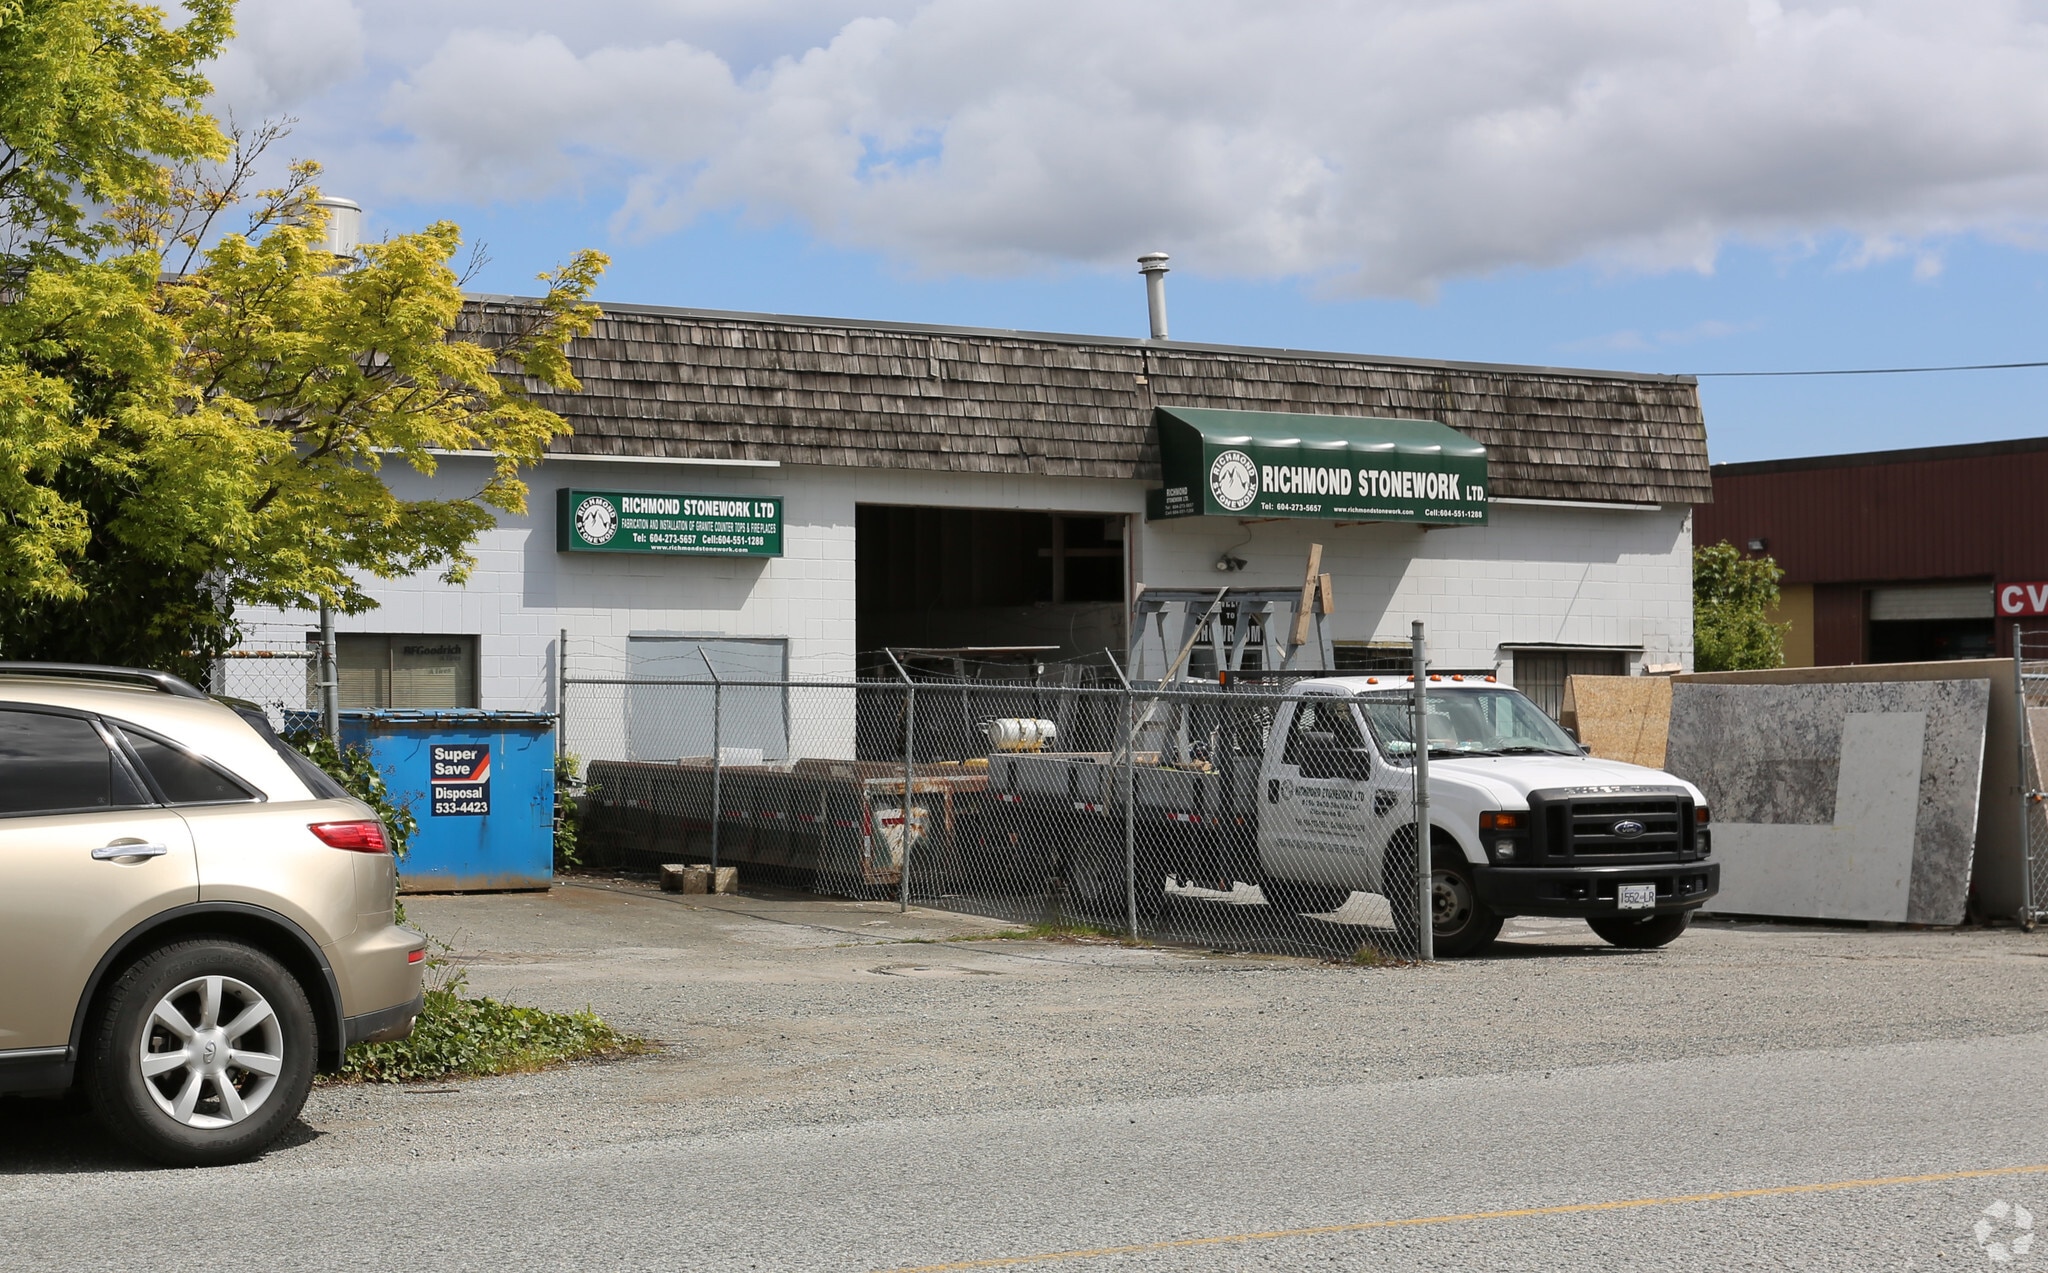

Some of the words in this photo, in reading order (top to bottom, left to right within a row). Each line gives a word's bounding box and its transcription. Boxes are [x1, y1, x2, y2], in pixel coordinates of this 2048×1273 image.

[1212, 453, 1256, 477] RICHMOND
[1262, 465, 1352, 496] RICHMOND
[1358, 469, 1461, 501] STONEWORK
[1466, 485, 1487, 502] LTD.
[1212, 481, 1256, 508] STONEWORK
[577, 498, 617, 518] RICHMOND
[621, 497, 680, 515] RICHMOND
[683, 499, 751, 518] STONEWORK
[754, 502, 775, 518] LTD
[1261, 502, 1274, 511] Tel:
[1276, 503, 1322, 513] 604-273-5657
[1333, 506, 1414, 516] www.richmondstonework.com
[576, 521, 617, 544] STONEWORK
[621, 518, 649, 530] FABRICATION
[650, 519, 659, 530] AND
[688, 521, 695, 531] OF
[714, 522, 734, 533] COUNTER
[735, 523, 746, 533] TOPS
[750, 523, 777, 534] FIREPLACES
[632, 533, 646, 542] Tel:
[649, 533, 697, 544] 604-273-5657
[650, 544, 749, 553] www.richmondstonework.com
[434, 747, 478, 763] Super
[434, 762, 471, 775] Save
[435, 786, 483, 802] Disposal
[435, 801, 488, 814] 533-4423
